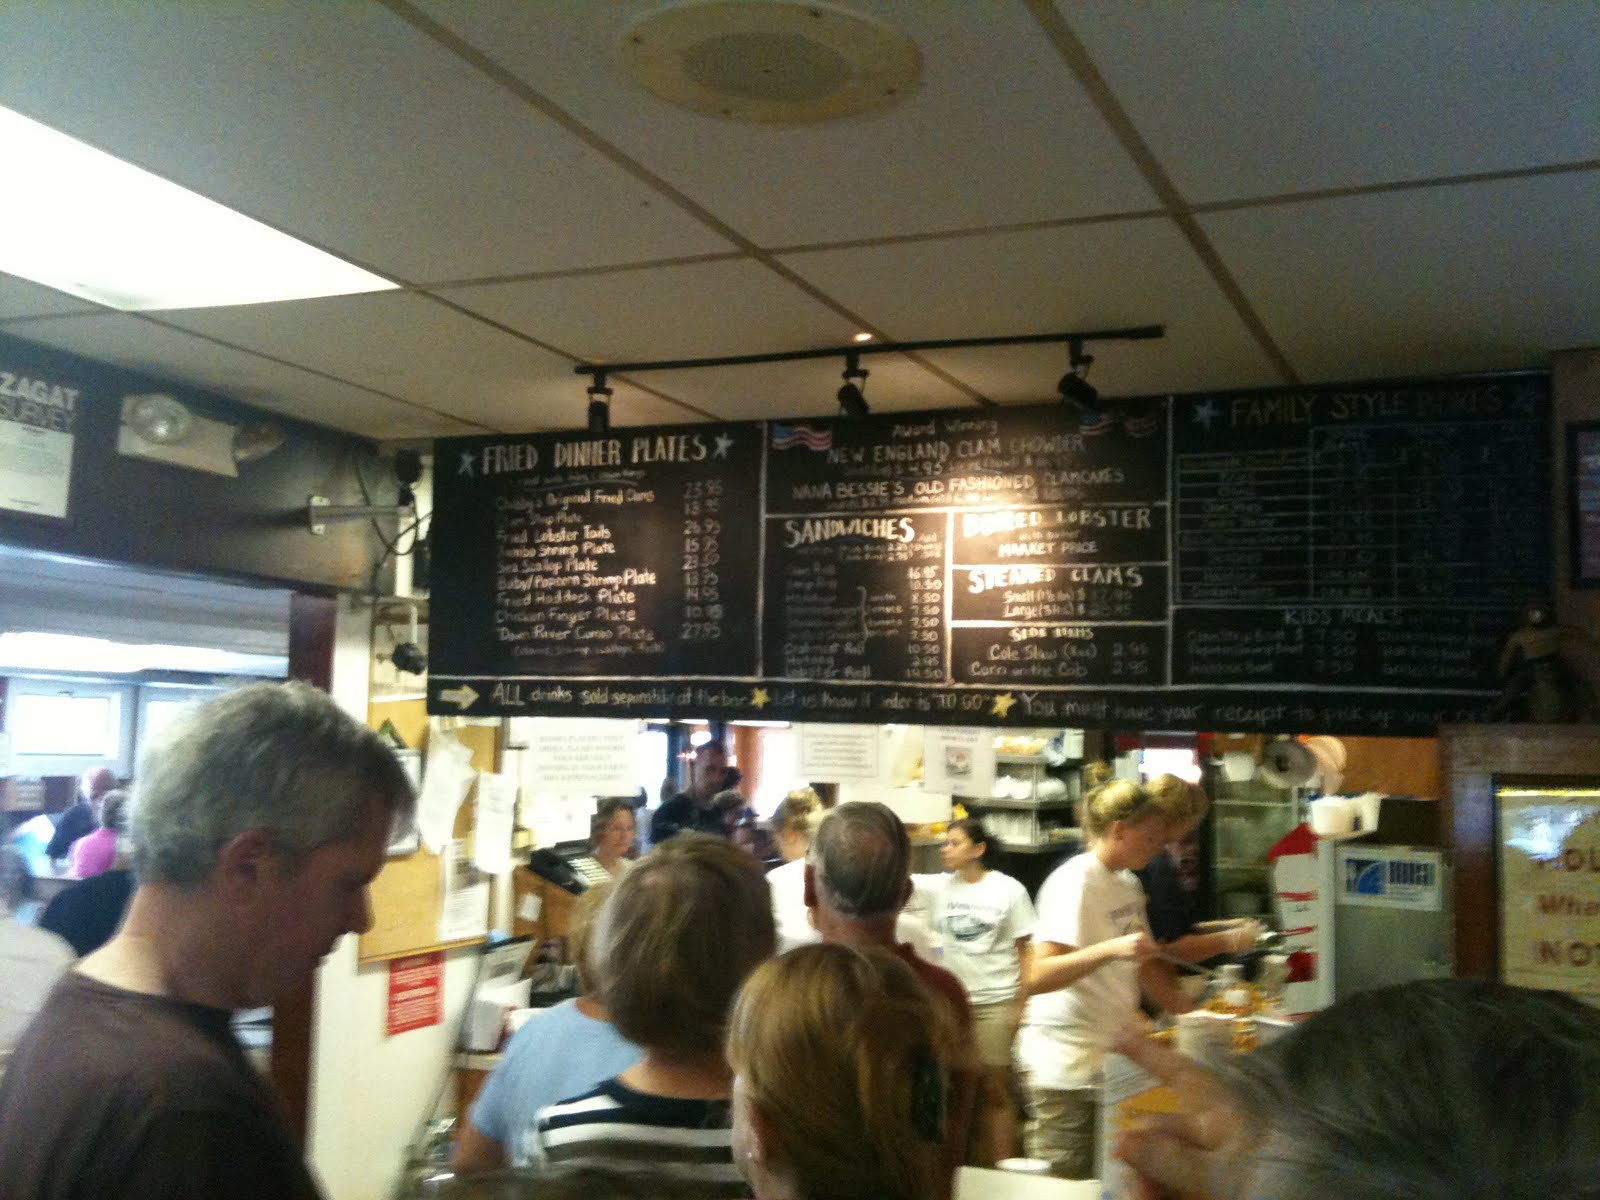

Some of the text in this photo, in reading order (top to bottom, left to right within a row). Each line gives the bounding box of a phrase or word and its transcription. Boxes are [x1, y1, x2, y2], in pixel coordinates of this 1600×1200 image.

[0, 371, 79, 411] ZAGAT
[1230, 396, 1315, 428] FAMILY
[1329, 390, 1409, 420] STYLE
[482, 434, 708, 475] FRIED DINNER PLATES
[826, 444, 866, 465] NEW
[872, 440, 950, 465] ENGLAND
[957, 437, 1001, 458] CLAM
[912, 479, 945, 496] OLD
[949, 473, 1036, 493] FASHIONED
[784, 517, 916, 548] SANDWICHES
[962, 508, 1151, 538] BED LOBSTER
[998, 541, 1056, 558] MARKET
[623, 567, 657, 586] Plate
[1070, 567, 1143, 588] CLAMS
[596, 587, 636, 604] Plate
[595, 606, 637, 622] Plate
[491, 682, 525, 706] ALL
[1017, 691, 1057, 717] You
